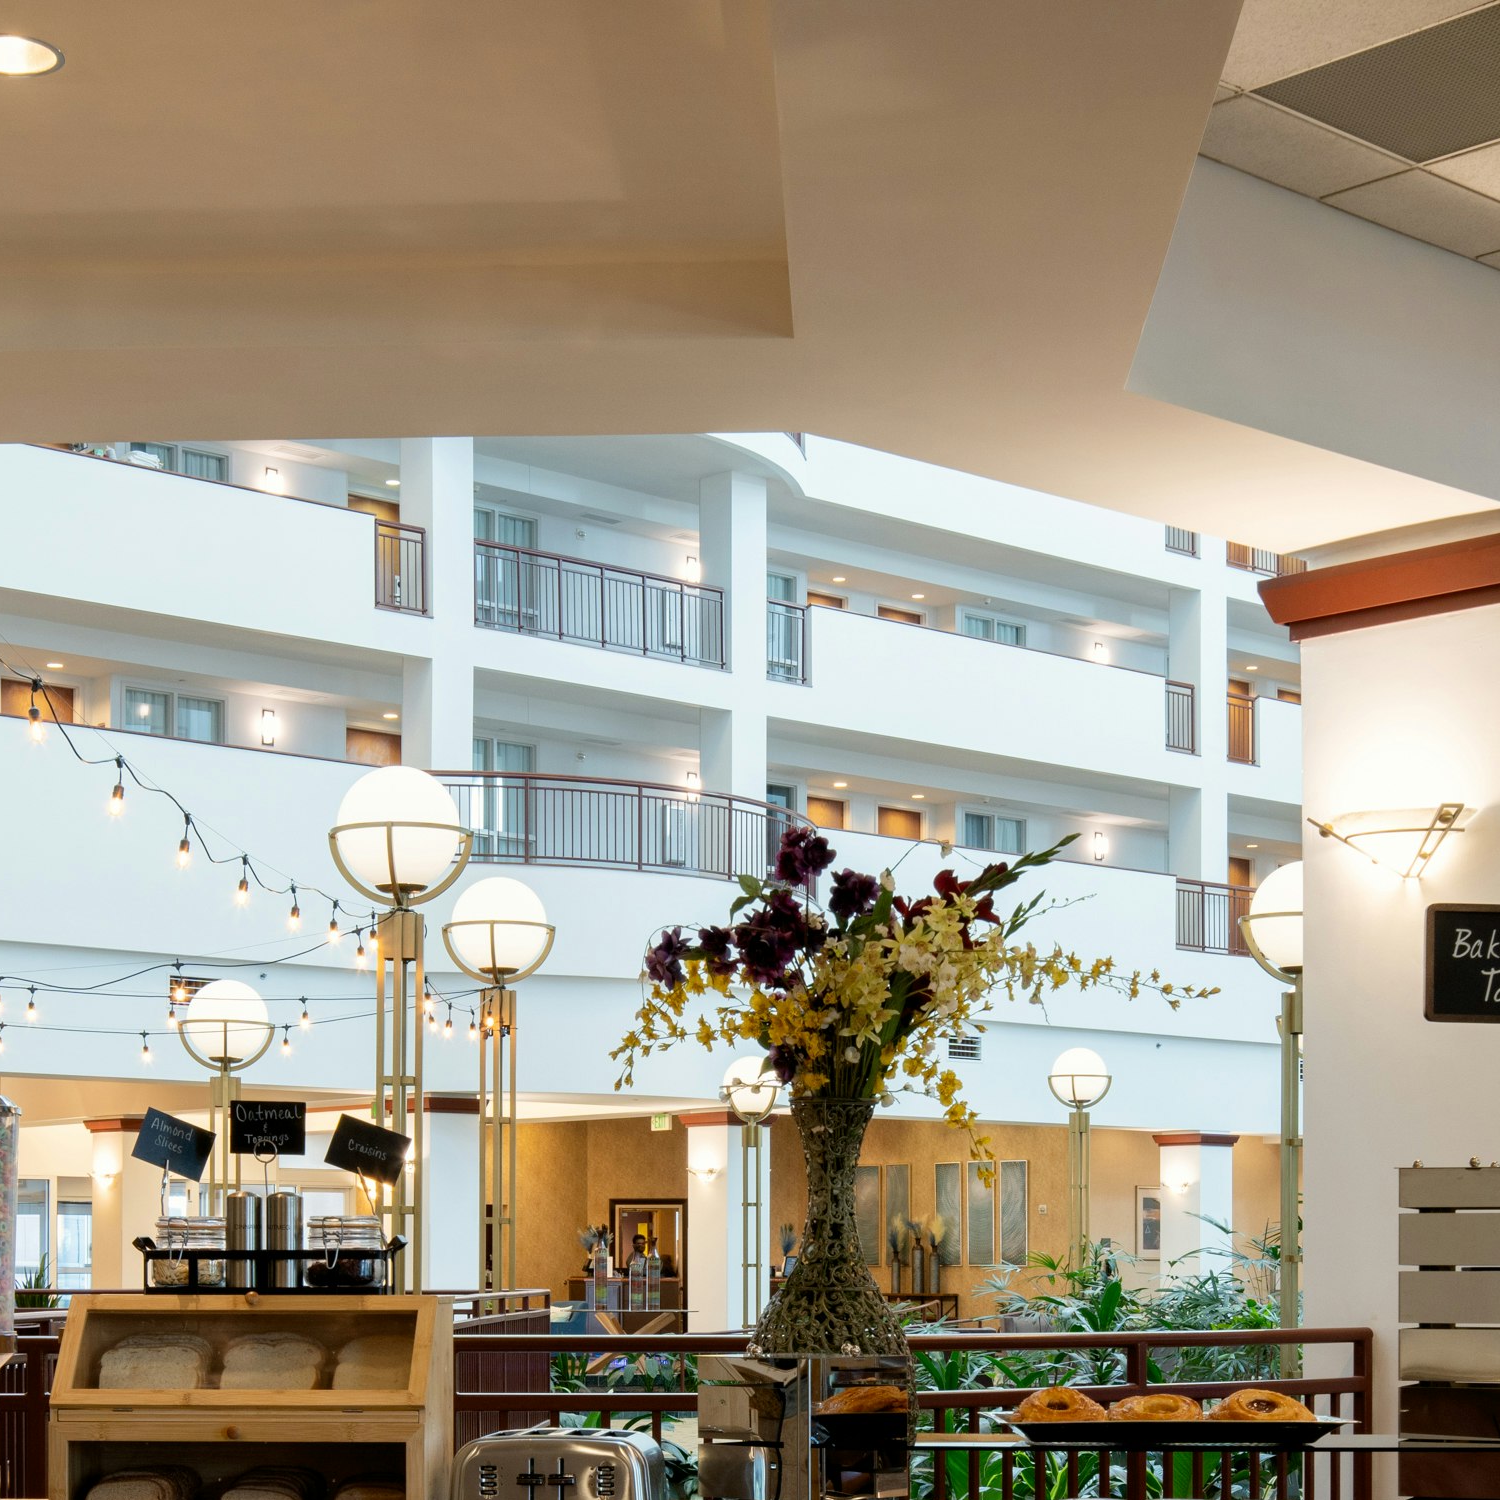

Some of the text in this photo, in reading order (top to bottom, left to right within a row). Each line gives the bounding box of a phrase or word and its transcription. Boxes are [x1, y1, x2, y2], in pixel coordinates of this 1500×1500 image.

[235, 1103, 302, 1122] Oatmeal
[150, 1117, 194, 1141] Almond
[154, 1134, 184, 1154] Slices
[347, 1138, 388, 1161] Craisins
